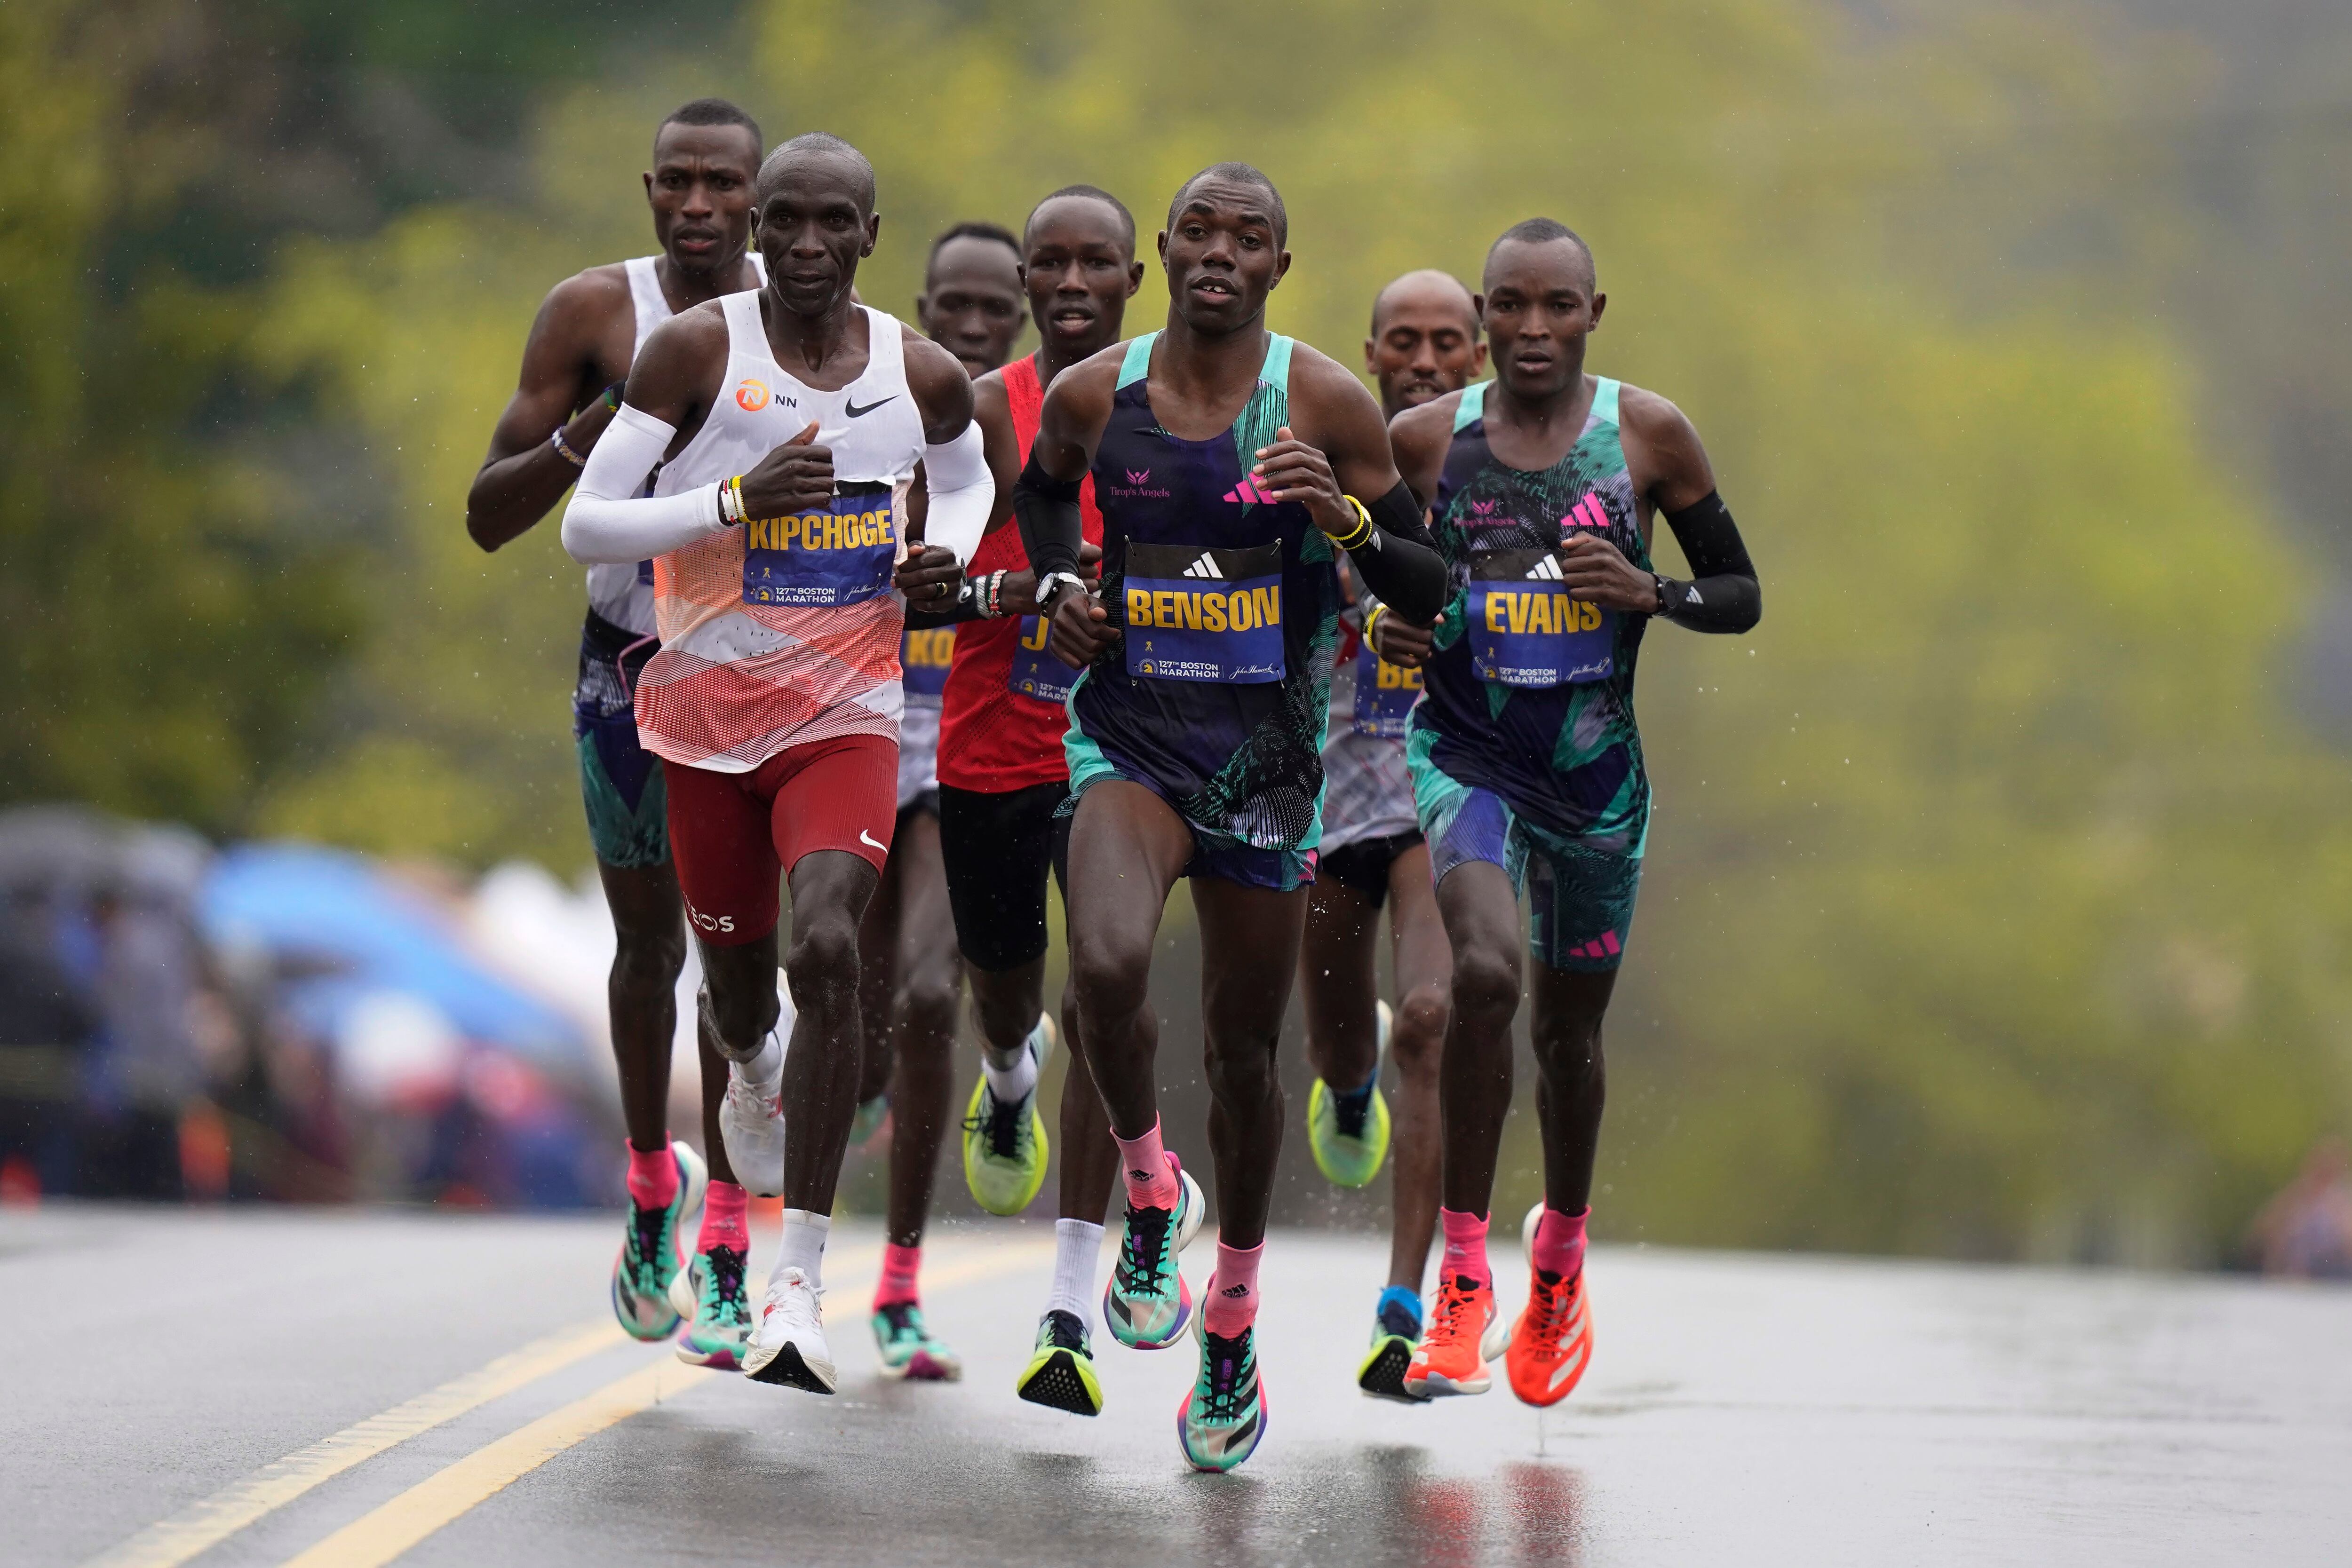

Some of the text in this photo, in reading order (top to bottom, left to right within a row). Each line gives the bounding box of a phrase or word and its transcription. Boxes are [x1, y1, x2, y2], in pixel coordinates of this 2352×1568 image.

[775, 394, 797, 408] NN
[1110, 486, 1170, 498] Tirop's Angels
[750, 509, 894, 550] KIPCHOGE
[1127, 585, 1280, 632] BENSON
[1485, 592, 1602, 634] EVANS
[1021, 612, 1049, 651] J
[1160, 668, 1219, 678] MARATHON
[1181, 662, 1218, 671] BOSTON
[1501, 675, 1556, 683] MARATHON
